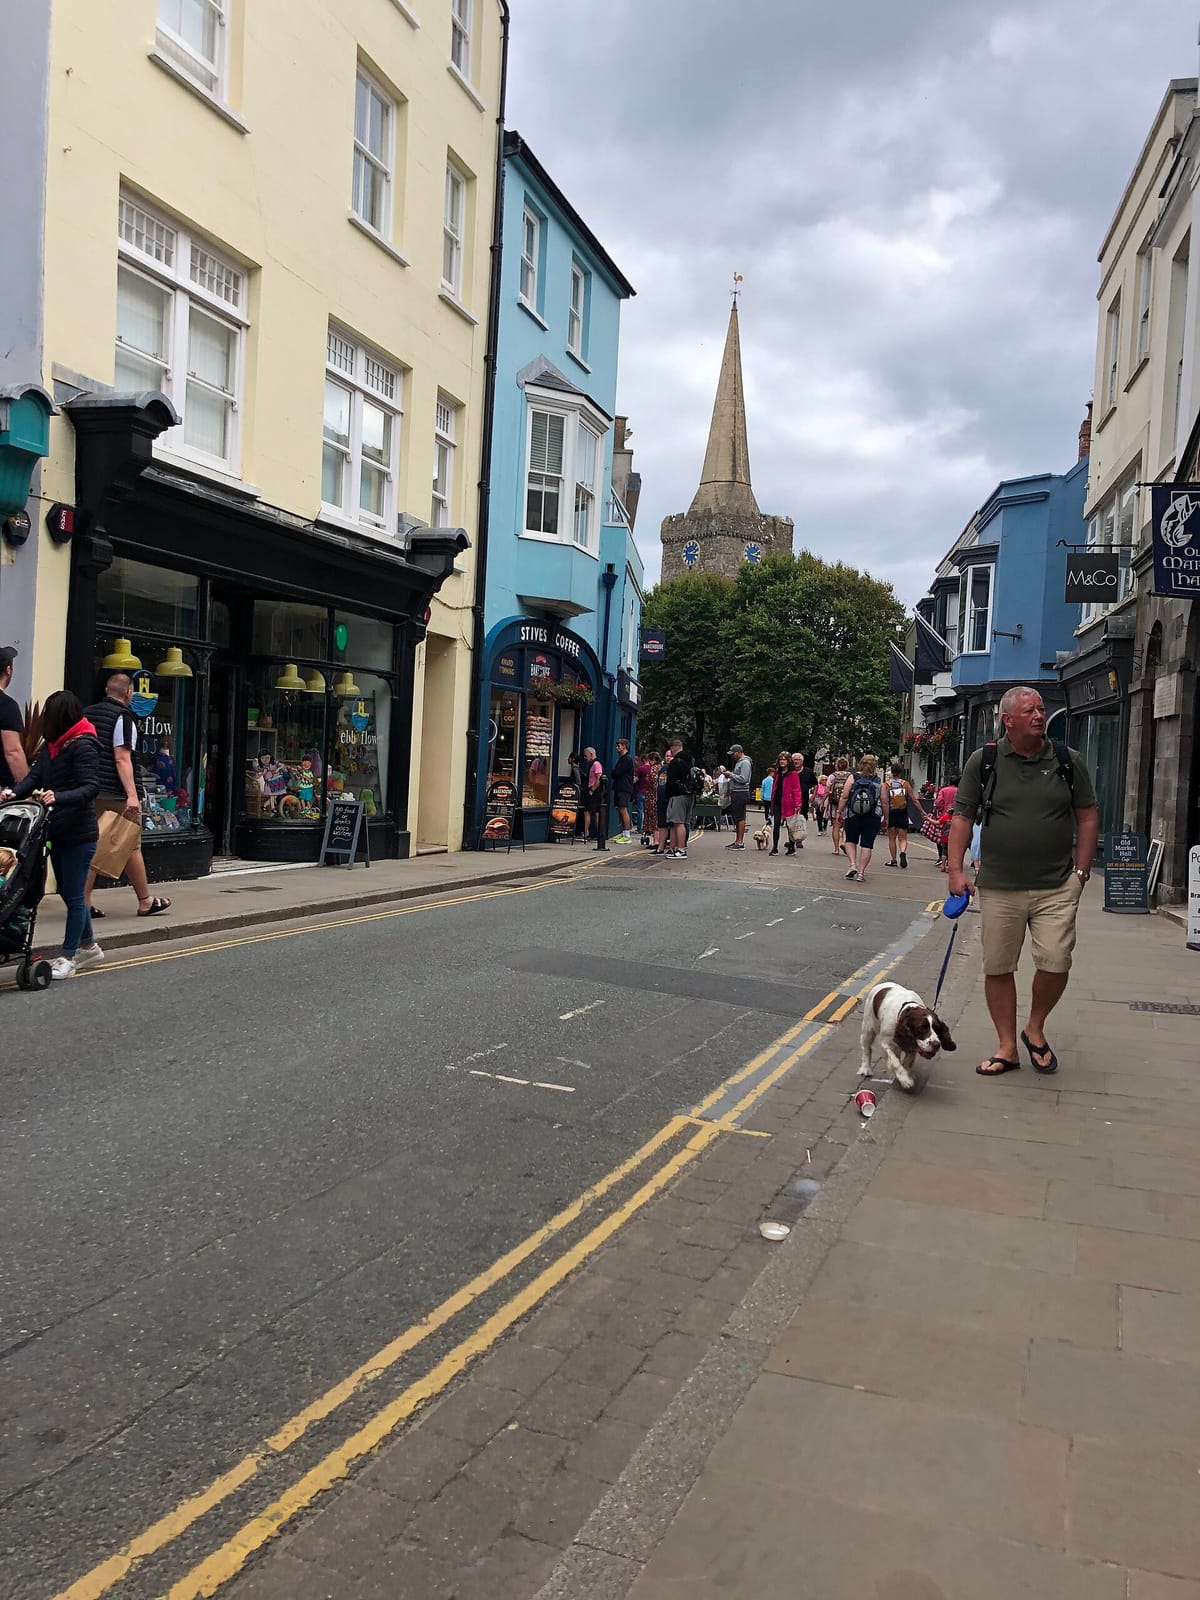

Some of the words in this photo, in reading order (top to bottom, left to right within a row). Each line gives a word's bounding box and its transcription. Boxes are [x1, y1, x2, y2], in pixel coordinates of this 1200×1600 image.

[1067, 570, 1117, 586] M&Co
[555, 633, 580, 657] COFFEE
[144, 716, 174, 736] flow
[340, 729, 355, 745] ebb
[361, 730, 378, 745] flow
